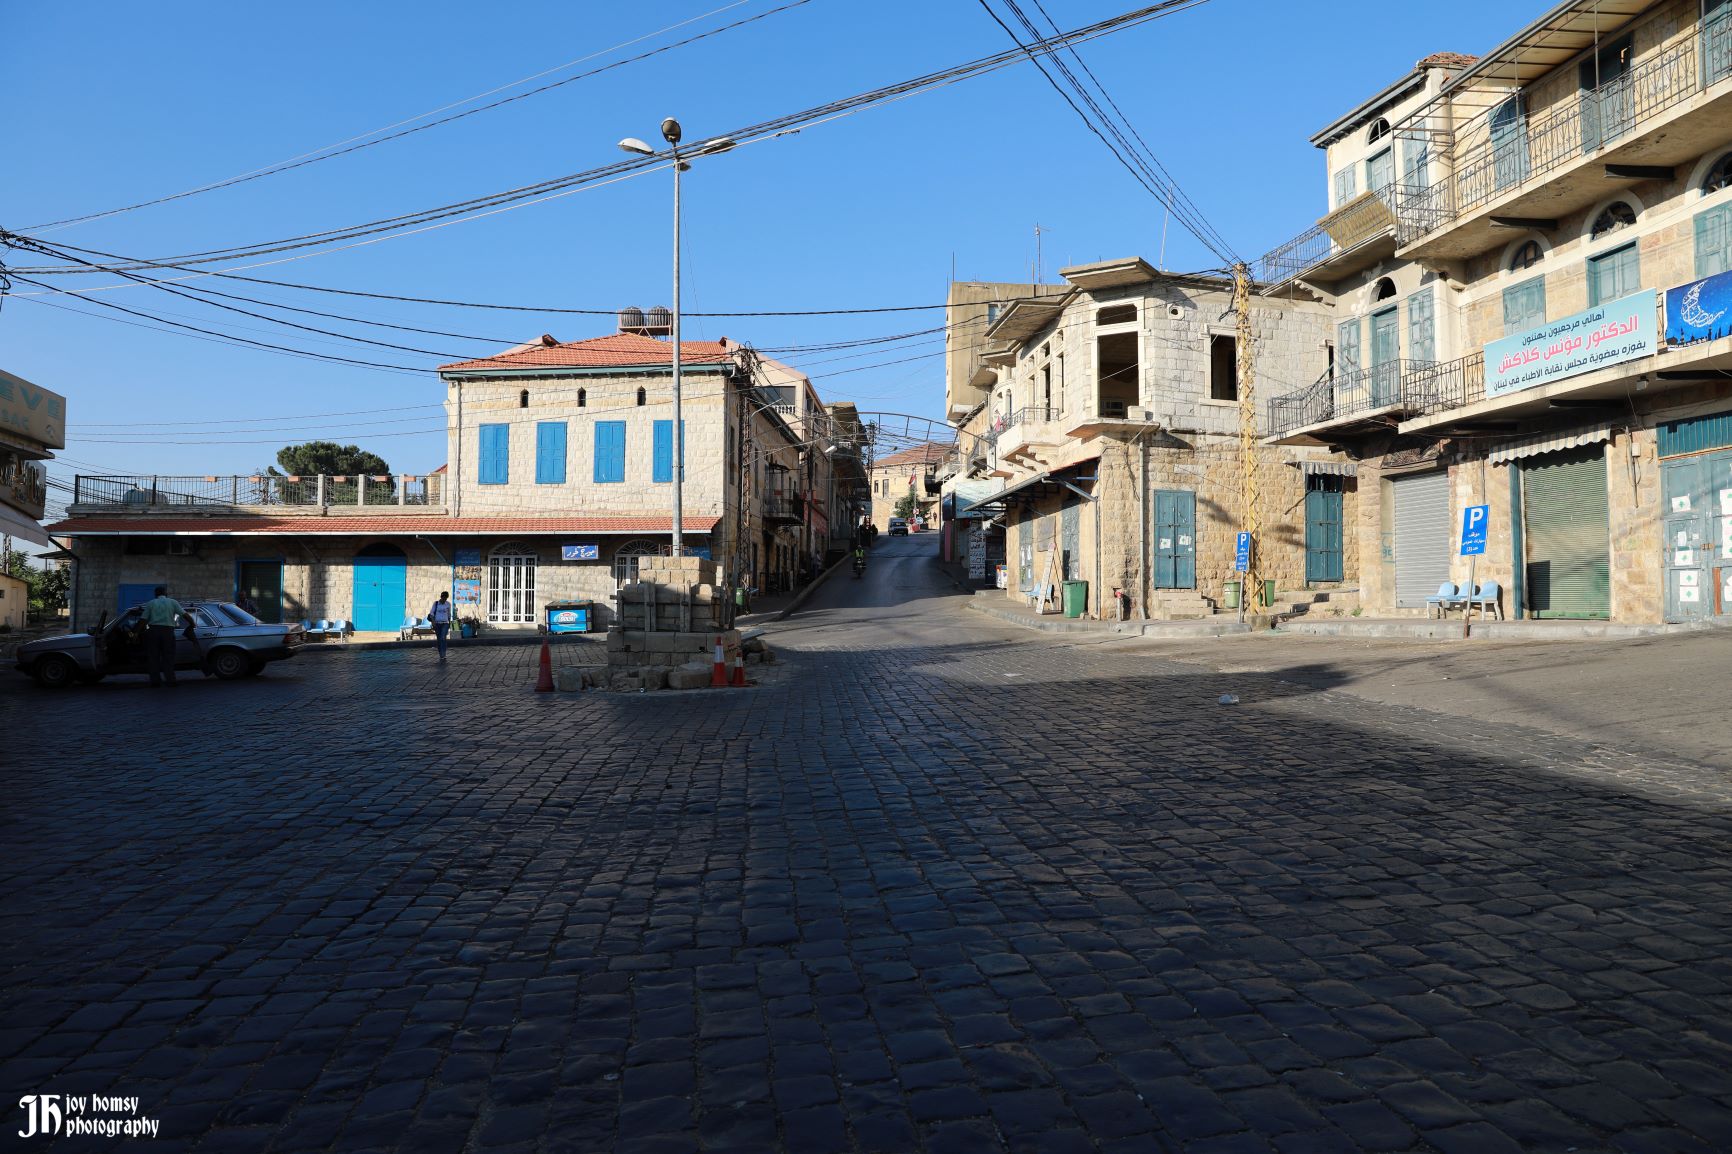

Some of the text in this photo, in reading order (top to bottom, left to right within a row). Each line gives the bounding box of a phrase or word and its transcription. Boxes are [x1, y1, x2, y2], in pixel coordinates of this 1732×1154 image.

[1548, 319, 1580, 338] مرجعيون
[1585, 313, 1638, 351] الدكتور
[1543, 335, 1582, 361] مؤنس
[1622, 340, 1646, 354] بفوزه
[1498, 345, 1540, 374] كلاكش
[1590, 347, 1620, 364] بعضوية
[1544, 363, 1563, 377] نقابة
[1564, 357, 1588, 372] مجلس
[1493, 380, 1508, 391] لبنان
[1509, 377, 1520, 387] في
[1469, 507, 1484, 530] P
[1240, 533, 1247, 546] P
